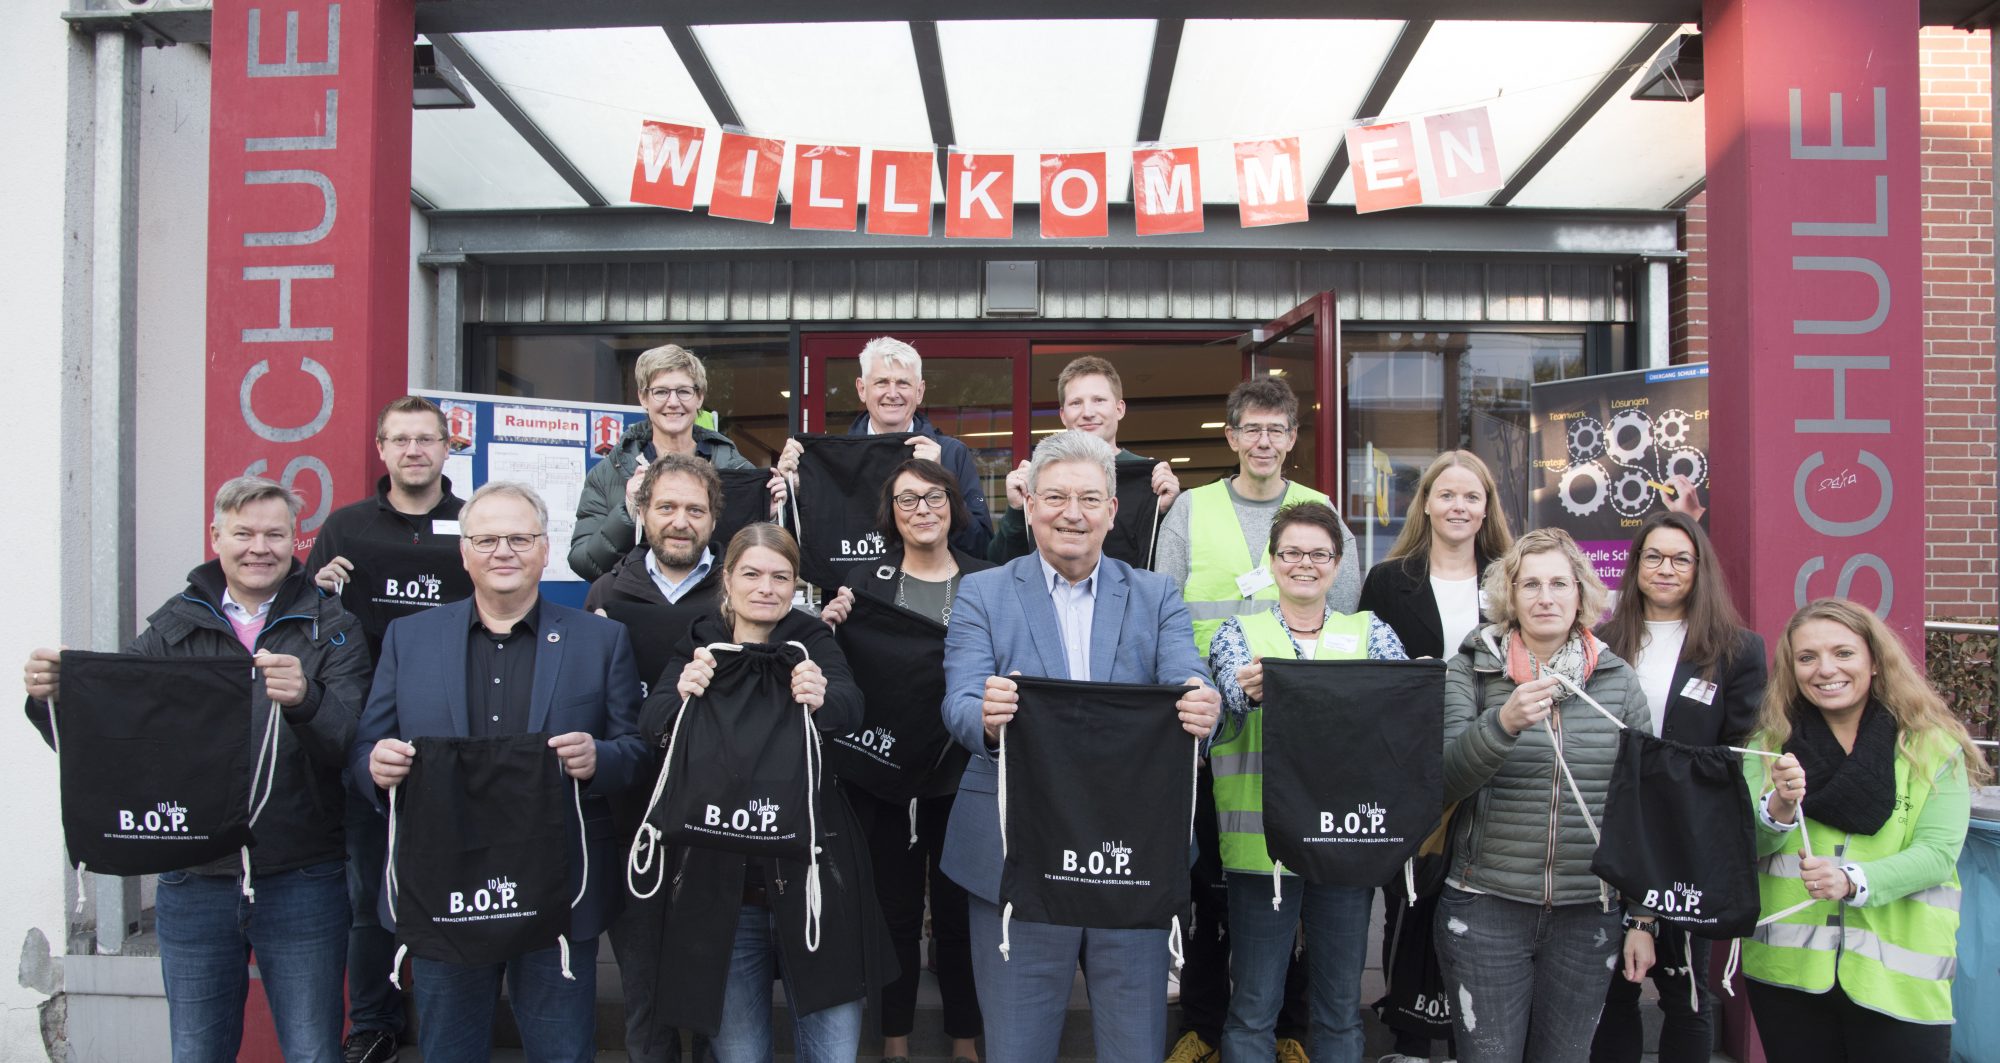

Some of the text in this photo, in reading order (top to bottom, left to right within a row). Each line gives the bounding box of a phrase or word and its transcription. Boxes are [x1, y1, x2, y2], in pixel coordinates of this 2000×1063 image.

[642, 126, 1485, 220] WILLKOMMEN
[1611, 397, 1649, 409] Lösungen
[505, 415, 580, 433] Raumplan
[1549, 410, 1586, 421] Teamwork
[1694, 410, 1709, 420] Erf
[1620, 518, 1643, 527] Ideen
[841, 540, 887, 555] B.O.P.
[1612, 549, 1630, 561] Sch
[386, 578, 441, 600] B.O.P.
[845, 729, 891, 758] .O.P.
[758, 797, 780, 815] Jahre
[120, 809, 189, 832] B.O.P.
[704, 804, 778, 833] B.O.P.
[1320, 811, 1387, 834] B.O.P.
[1111, 840, 1133, 857] Jahre
[1063, 849, 1131, 876] B.O.P.
[450, 888, 518, 914] B.O.P.
[1642, 889, 1701, 915] B.O.P.
